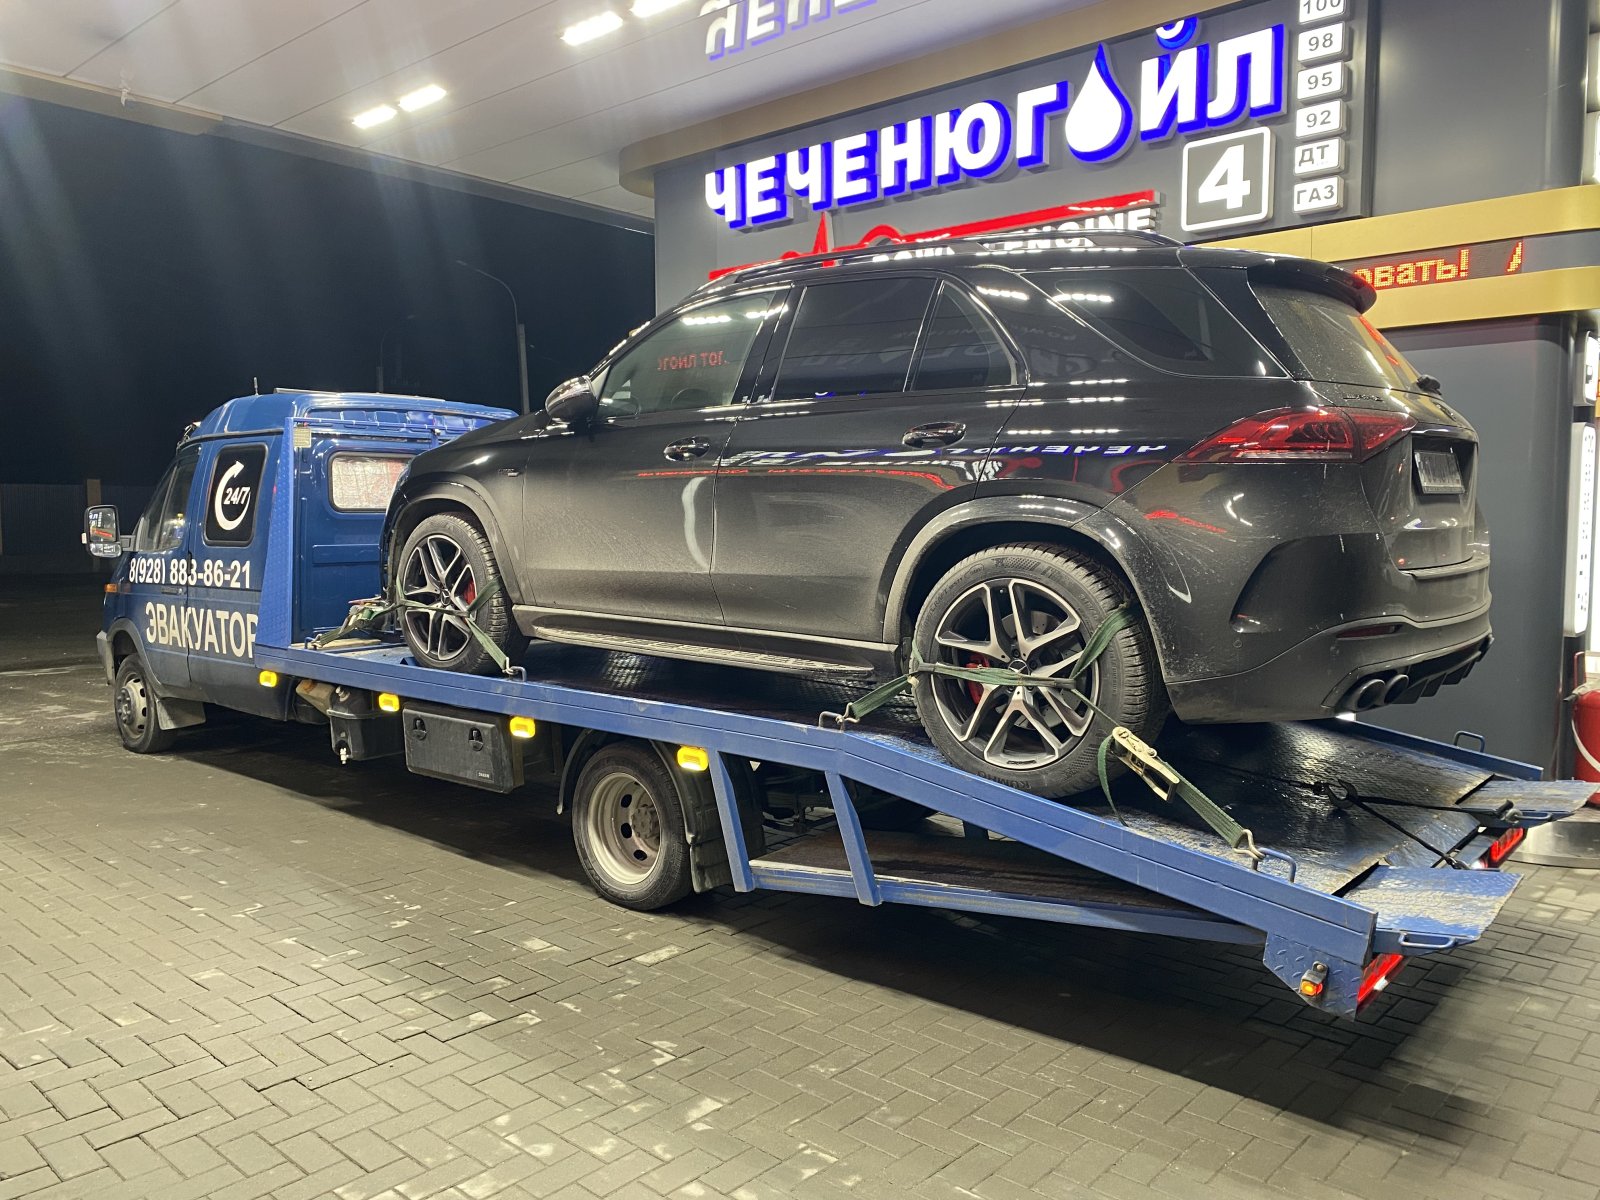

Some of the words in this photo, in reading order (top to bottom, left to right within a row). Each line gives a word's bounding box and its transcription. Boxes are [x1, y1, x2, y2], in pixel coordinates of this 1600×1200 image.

[1308, 33, 1334, 52] 98
[1307, 71, 1333, 90] 95
[1306, 110, 1332, 128] 92
[1298, 145, 1330, 167] ДТ
[1198, 146, 1251, 210] 4
[1297, 185, 1335, 205] ГАЗ
[223, 486, 250, 505] 24/7
[128, 557, 166, 584] 8(928)
[169, 558, 251, 589] 883-86-21
[145, 601, 259, 659] ЭВАКУАТОР
